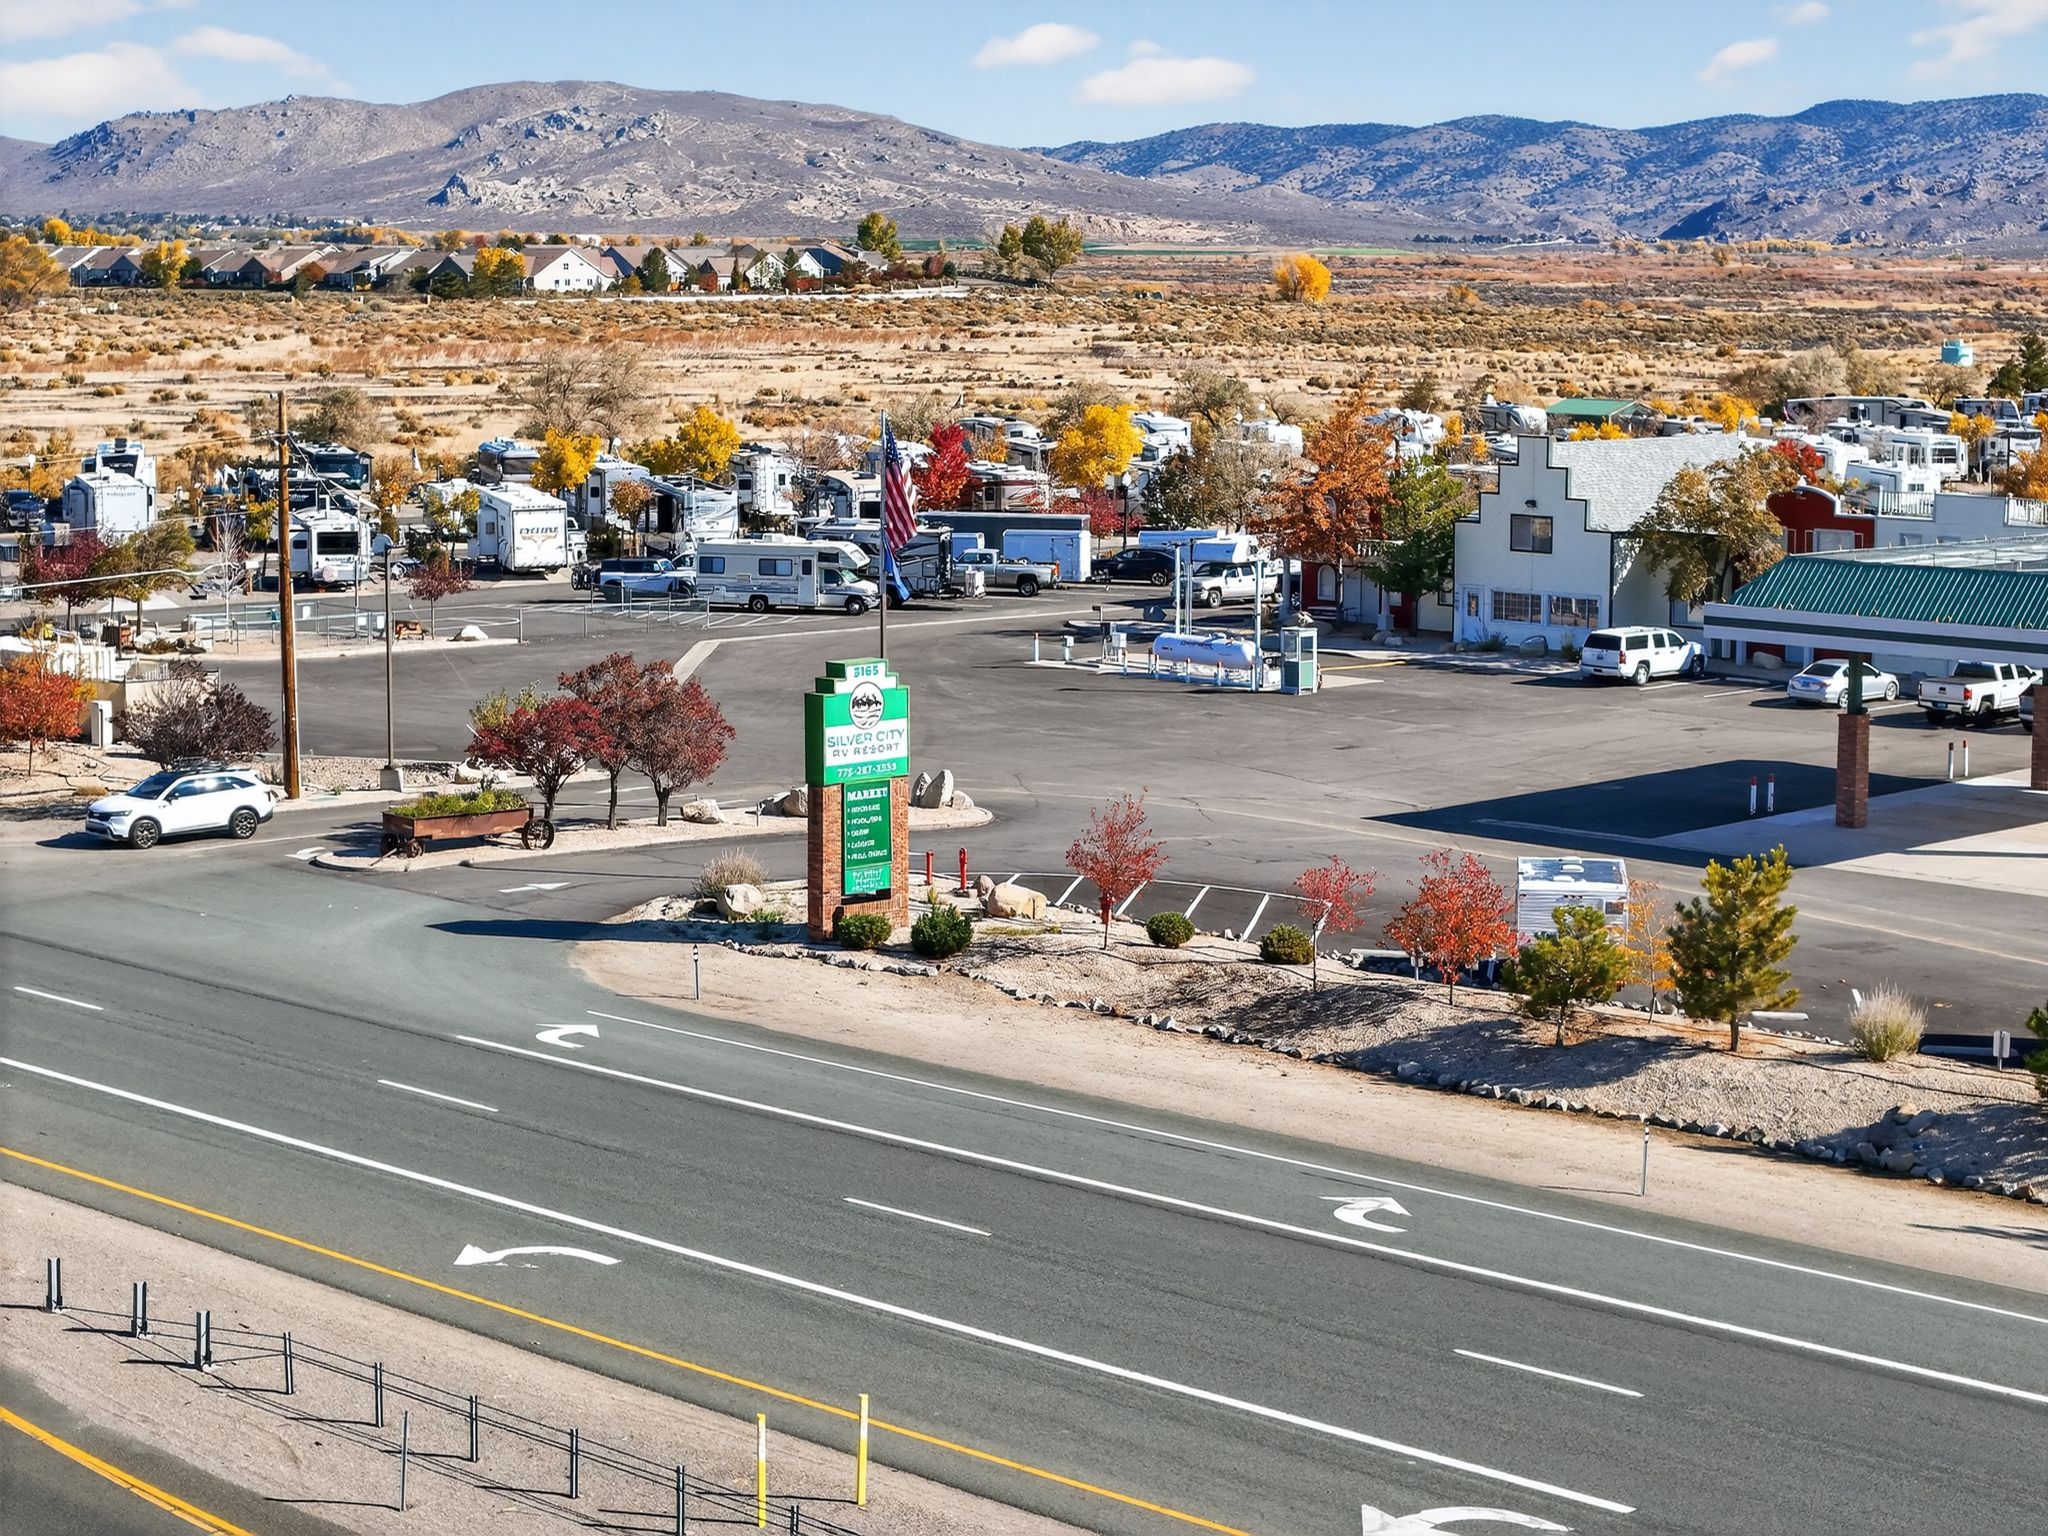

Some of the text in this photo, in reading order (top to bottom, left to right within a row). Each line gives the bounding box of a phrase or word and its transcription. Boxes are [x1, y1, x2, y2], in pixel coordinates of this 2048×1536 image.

[827, 729, 905, 748] SILVER CITY
[832, 742, 900, 758] RV RESORT
